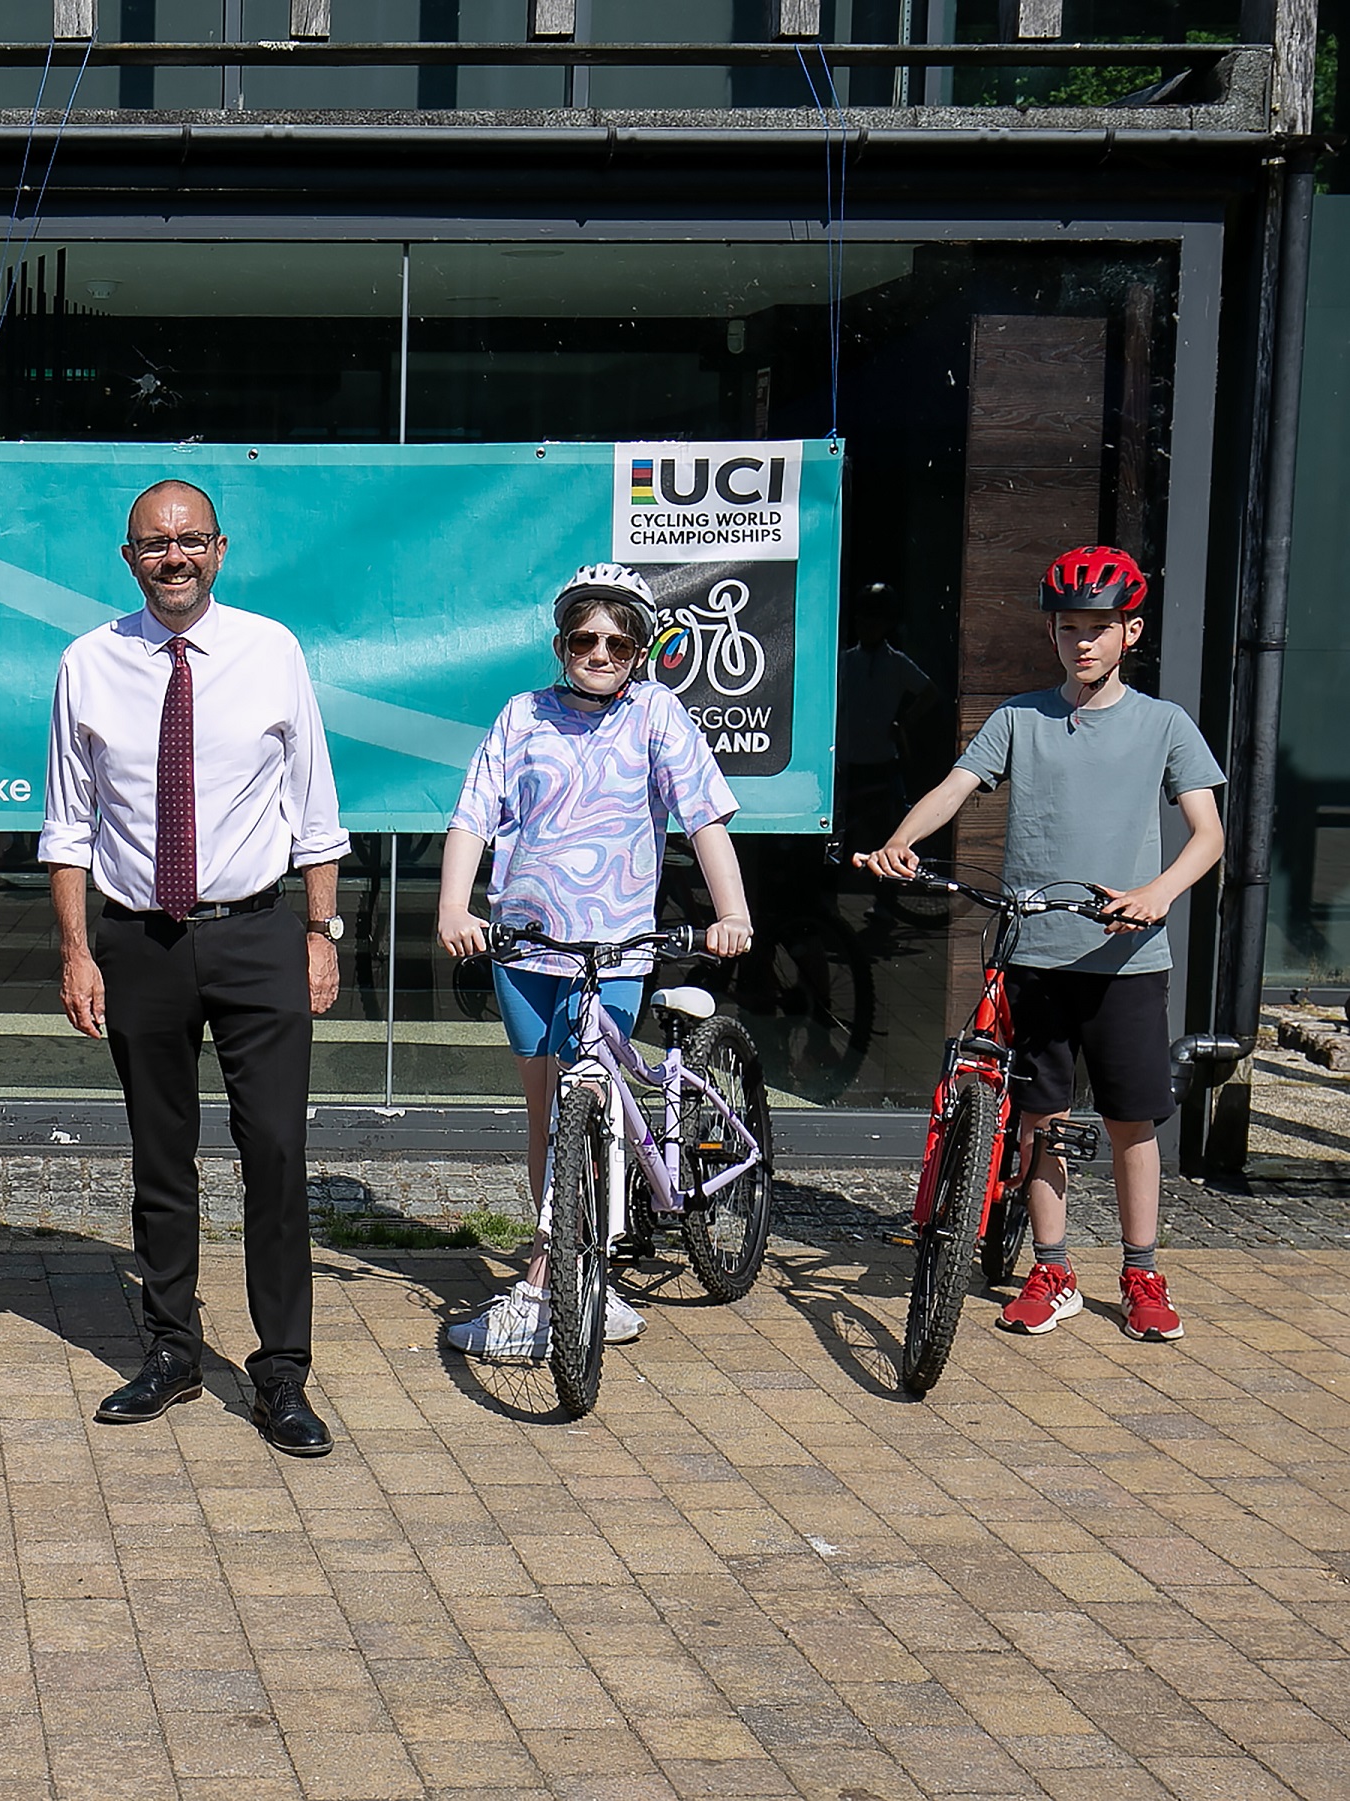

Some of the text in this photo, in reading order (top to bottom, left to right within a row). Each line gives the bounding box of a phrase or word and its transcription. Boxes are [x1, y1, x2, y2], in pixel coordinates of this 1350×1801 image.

[661, 457, 785, 505] UCI
[631, 511, 781, 528] CYCLING WORLD
[630, 528, 781, 545] CHAMPIONSHIPS
[688, 706, 772, 729] SGOW
